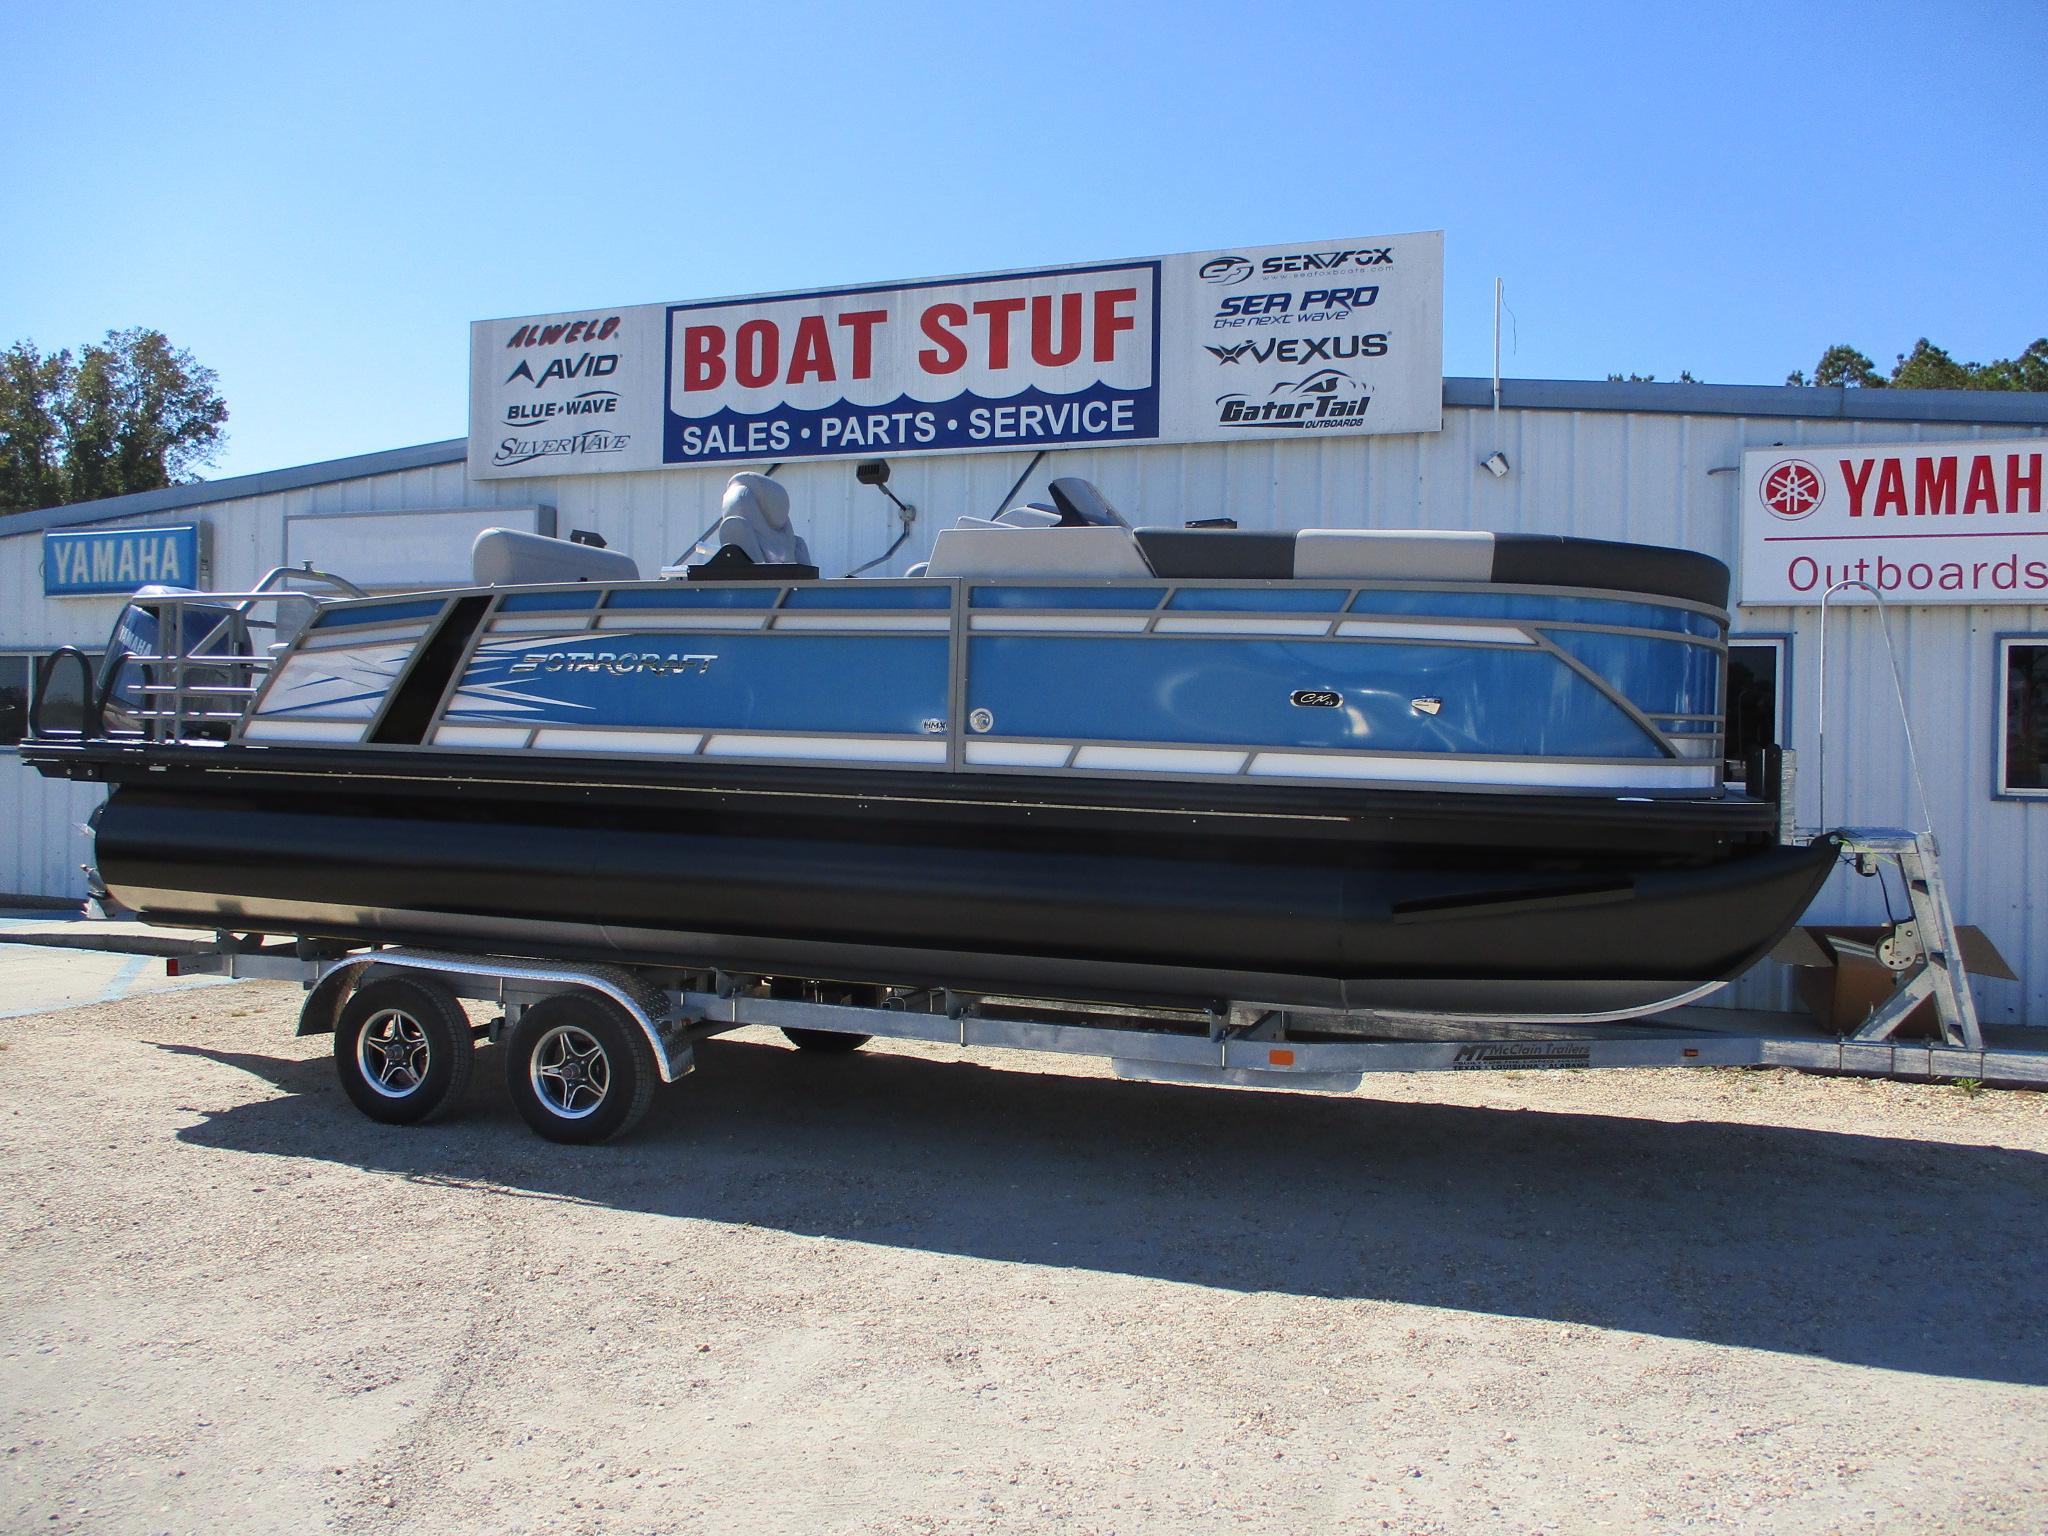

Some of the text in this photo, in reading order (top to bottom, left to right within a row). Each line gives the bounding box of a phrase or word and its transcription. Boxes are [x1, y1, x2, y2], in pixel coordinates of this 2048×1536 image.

[1215, 286, 1380, 317] SEA PRO
[507, 316, 621, 349] ALWELD
[1213, 310, 1349, 329] the next wave
[684, 288, 1137, 392] BOAT STUF
[1251, 333, 1388, 365] VEXUS
[535, 352, 619, 389] AVID
[682, 400, 1135, 455] SALES PARTS SERVICE
[1305, 418, 1364, 429] OUTBOARDS
[1839, 454, 2048, 517] YAMAH
[54, 538, 179, 584] YAMAHA
[1788, 554, 2048, 592] Outboards
[119, 625, 152, 656] YAMAHA
[1488, 1044, 1541, 1056] McClain
[1545, 1042, 1591, 1055] Trailers
